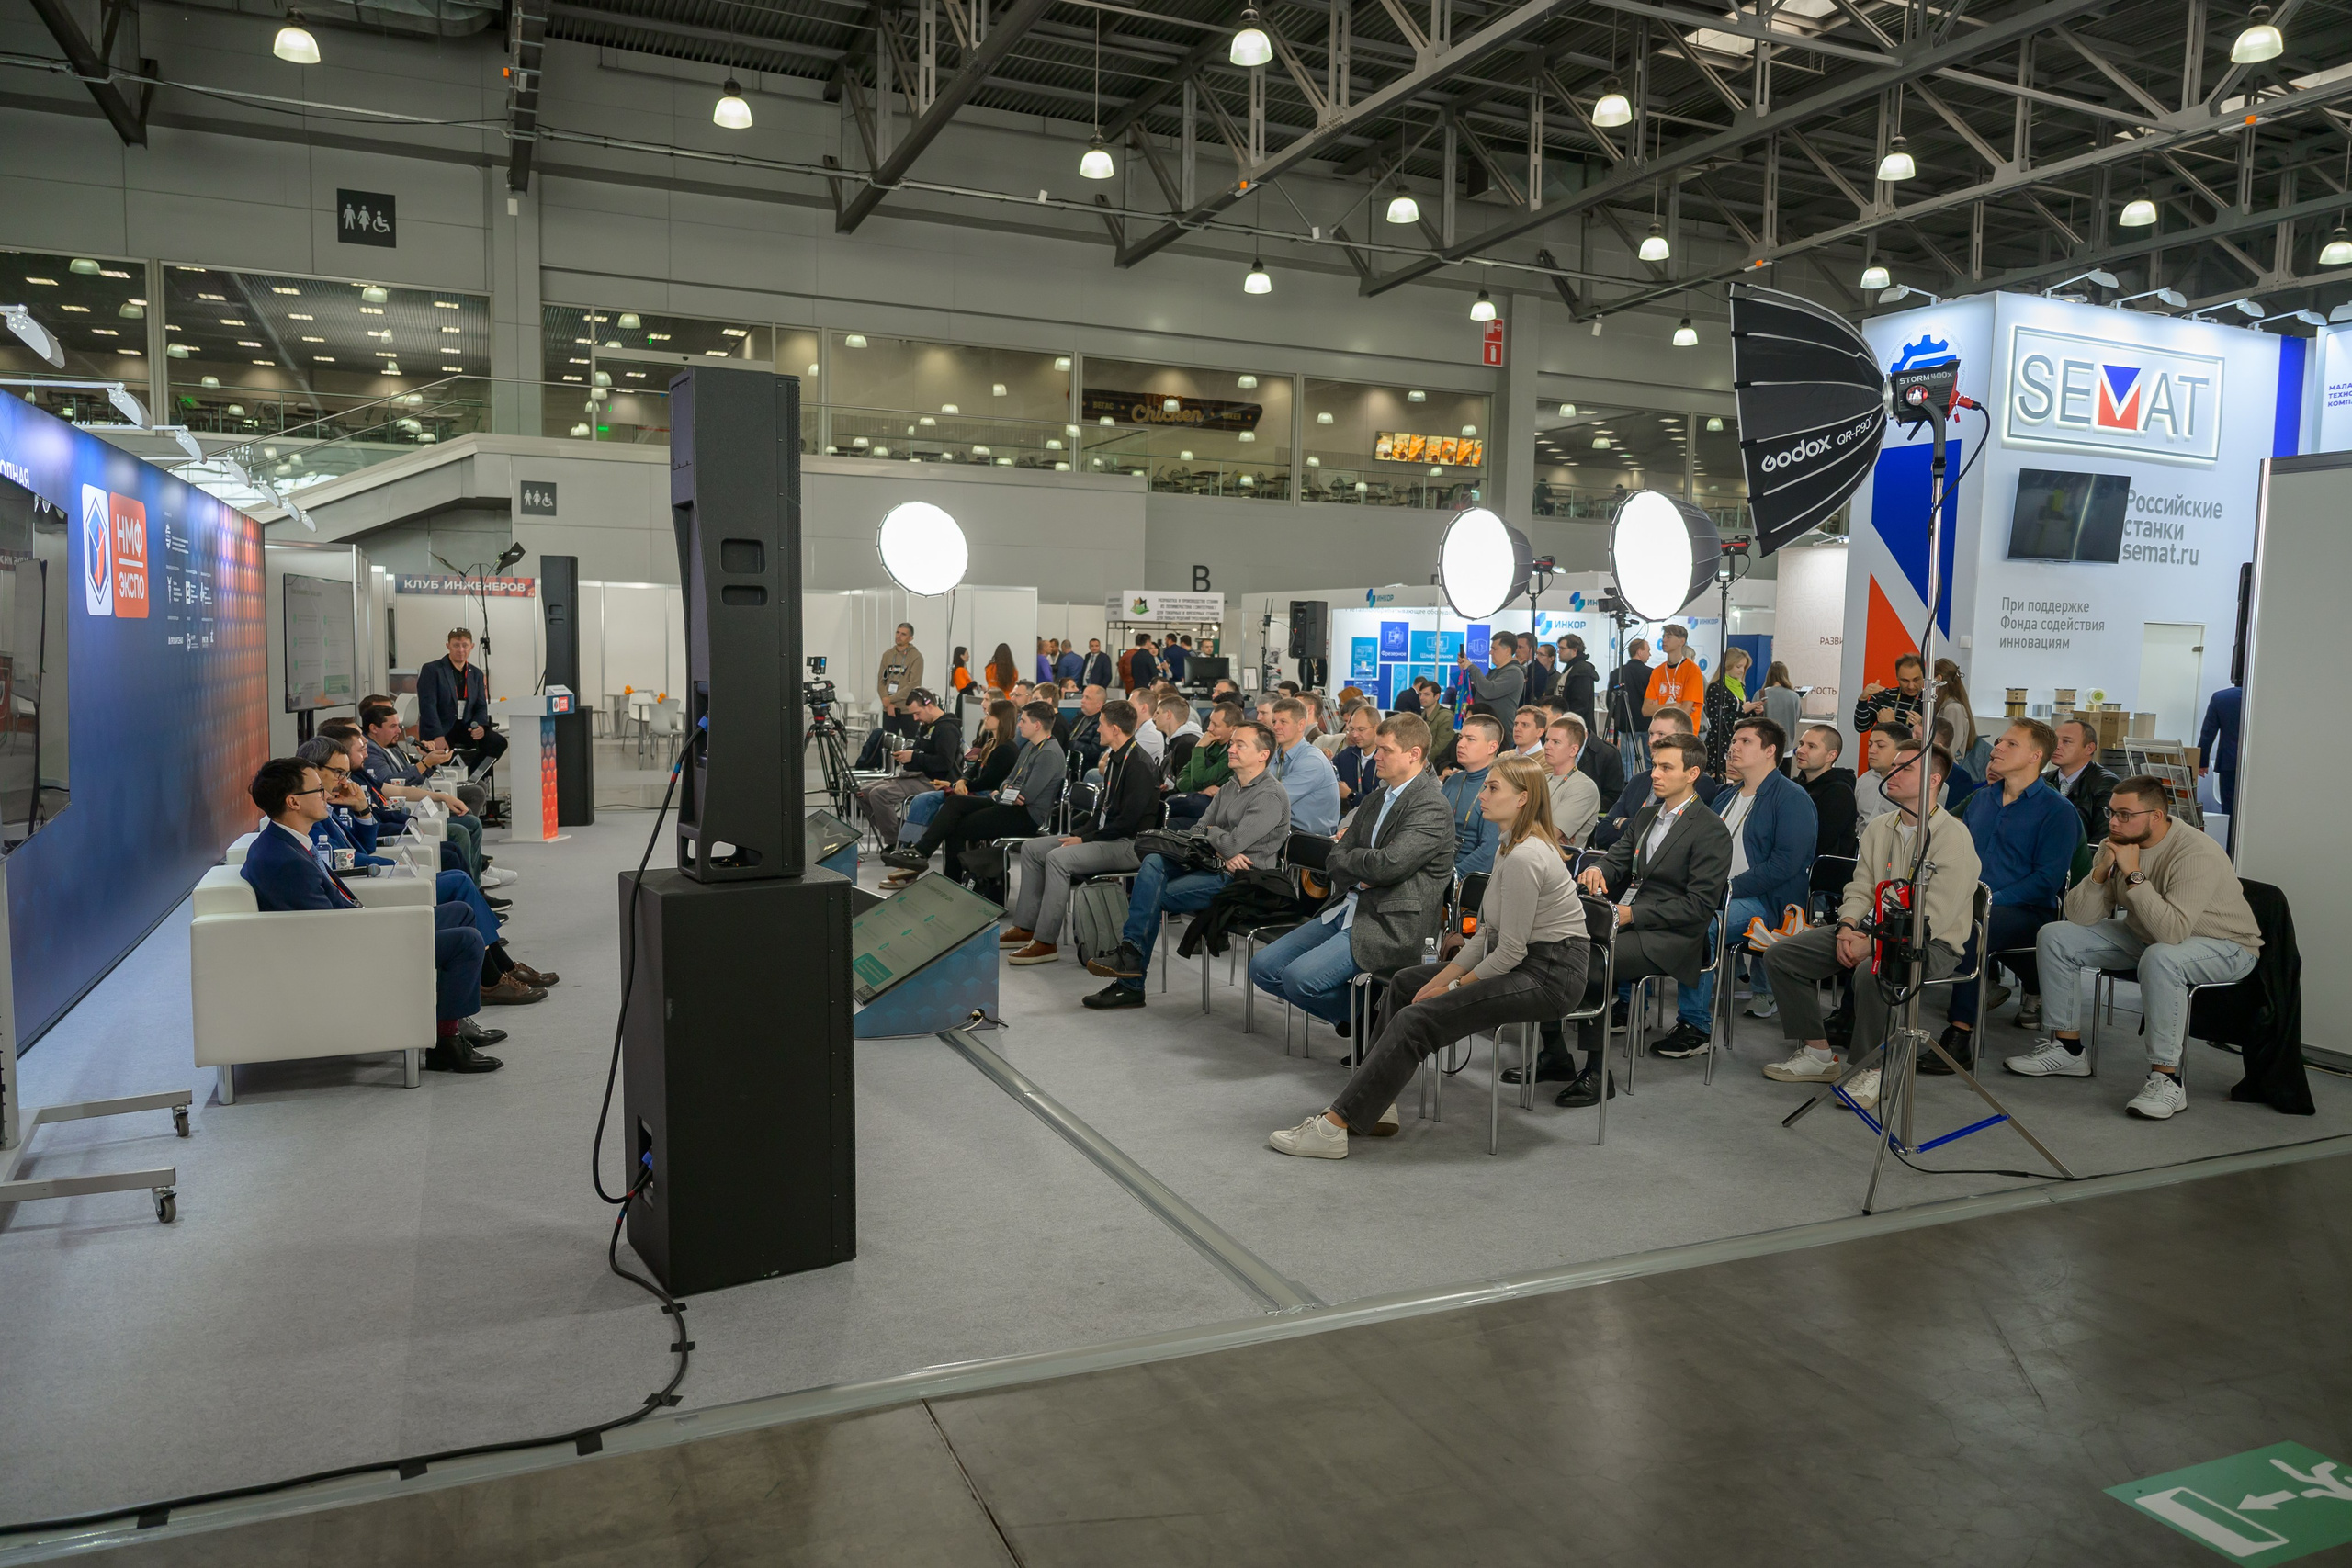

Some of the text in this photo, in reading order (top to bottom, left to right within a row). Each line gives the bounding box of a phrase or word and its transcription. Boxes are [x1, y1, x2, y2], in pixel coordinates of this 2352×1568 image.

[1899, 371, 1952, 385] STORM 400x
[2016, 353, 2210, 439] SEMAT
[2327, 399, 2352, 407] КОМП
[1761, 414, 1873, 473] Godox QR-P90T
[116, 513, 143, 558] НМФ
[2123, 519, 2185, 540] станки
[2121, 543, 2199, 566] semat.ru
[119, 571, 144, 599] ЭКСПО
[403, 580, 526, 592] КЛУБ ИНЖЕНЕРОВ
[1377, 593, 1394, 602] ИНКОР
[2002, 597, 2090, 615] При поддержке
[1555, 619, 1587, 630] ИНКОР
[2000, 615, 2105, 632] Фонда содействия
[1999, 637, 2070, 651] инновациям
